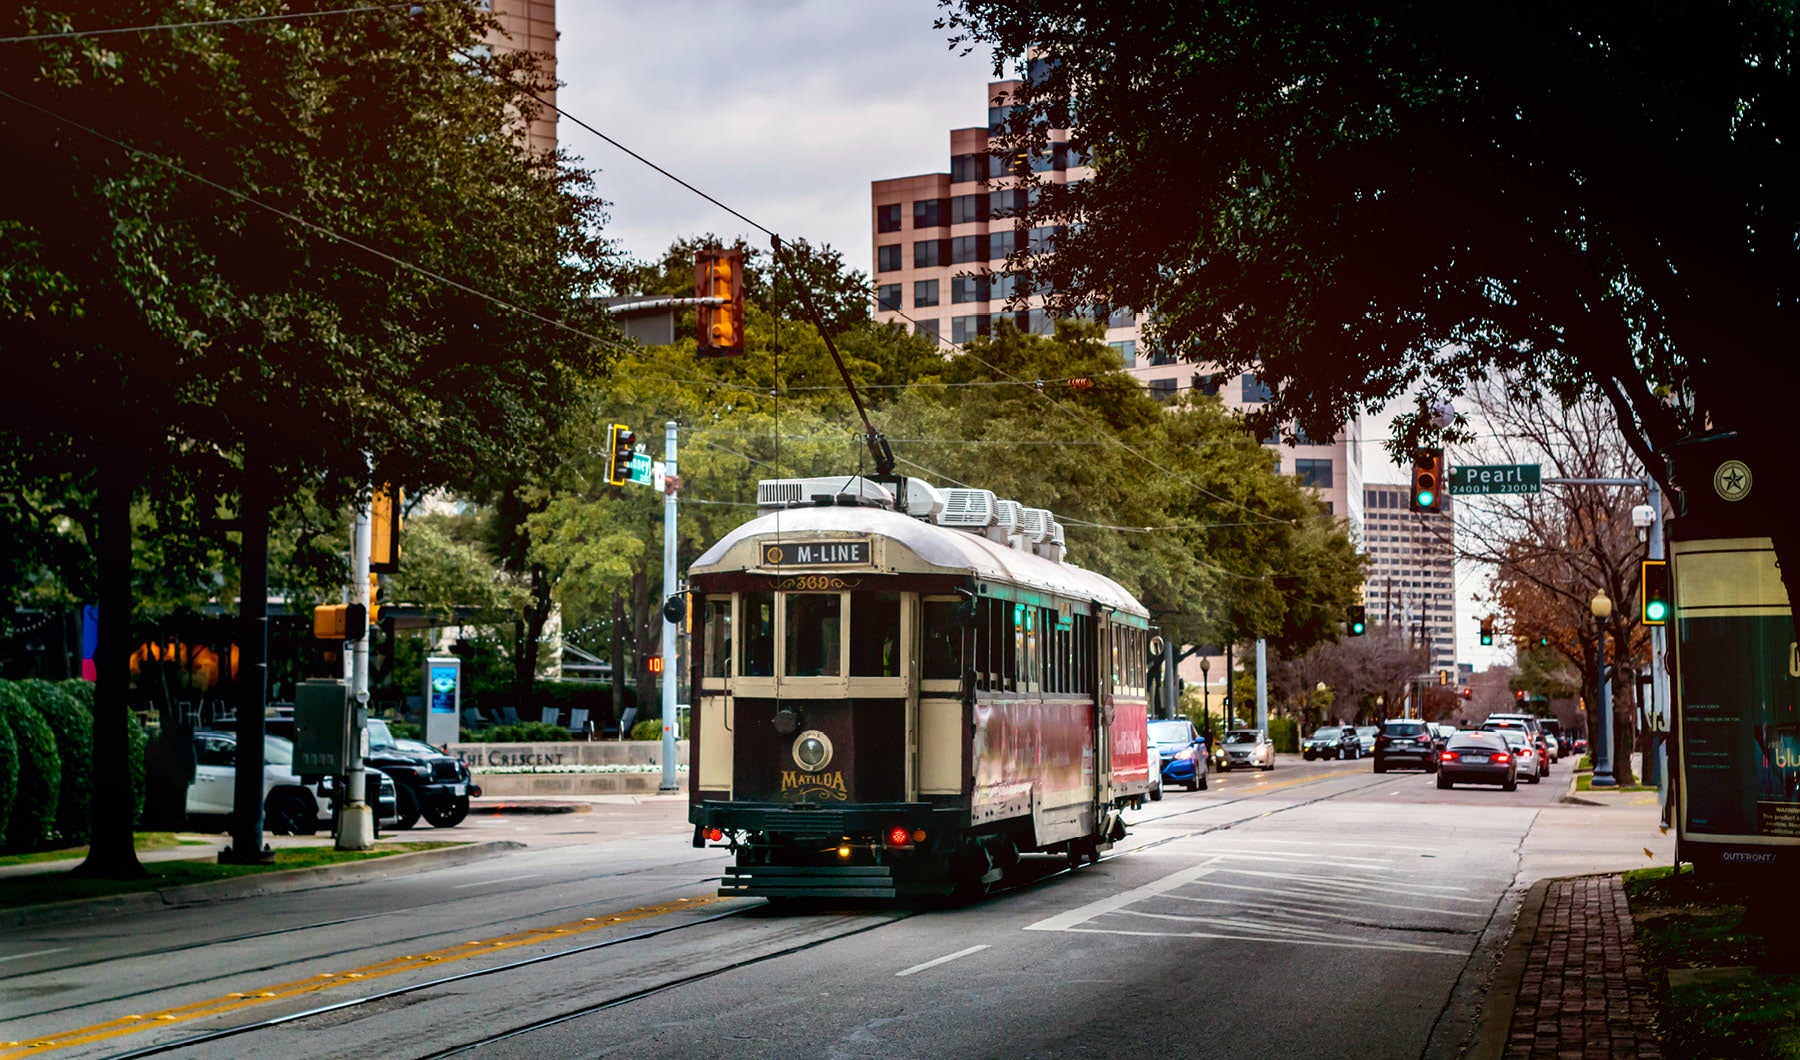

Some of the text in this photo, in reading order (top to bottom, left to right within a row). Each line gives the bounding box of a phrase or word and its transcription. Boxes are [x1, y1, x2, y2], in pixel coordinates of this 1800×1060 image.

[1466, 467, 1523, 483] Pearl
[797, 544, 860, 563] M-LINE
[795, 575, 829, 590] 369
[648, 657, 661, 672] 10
[488, 750, 563, 766] CRESCENT
[1775, 746, 1800, 769] blu
